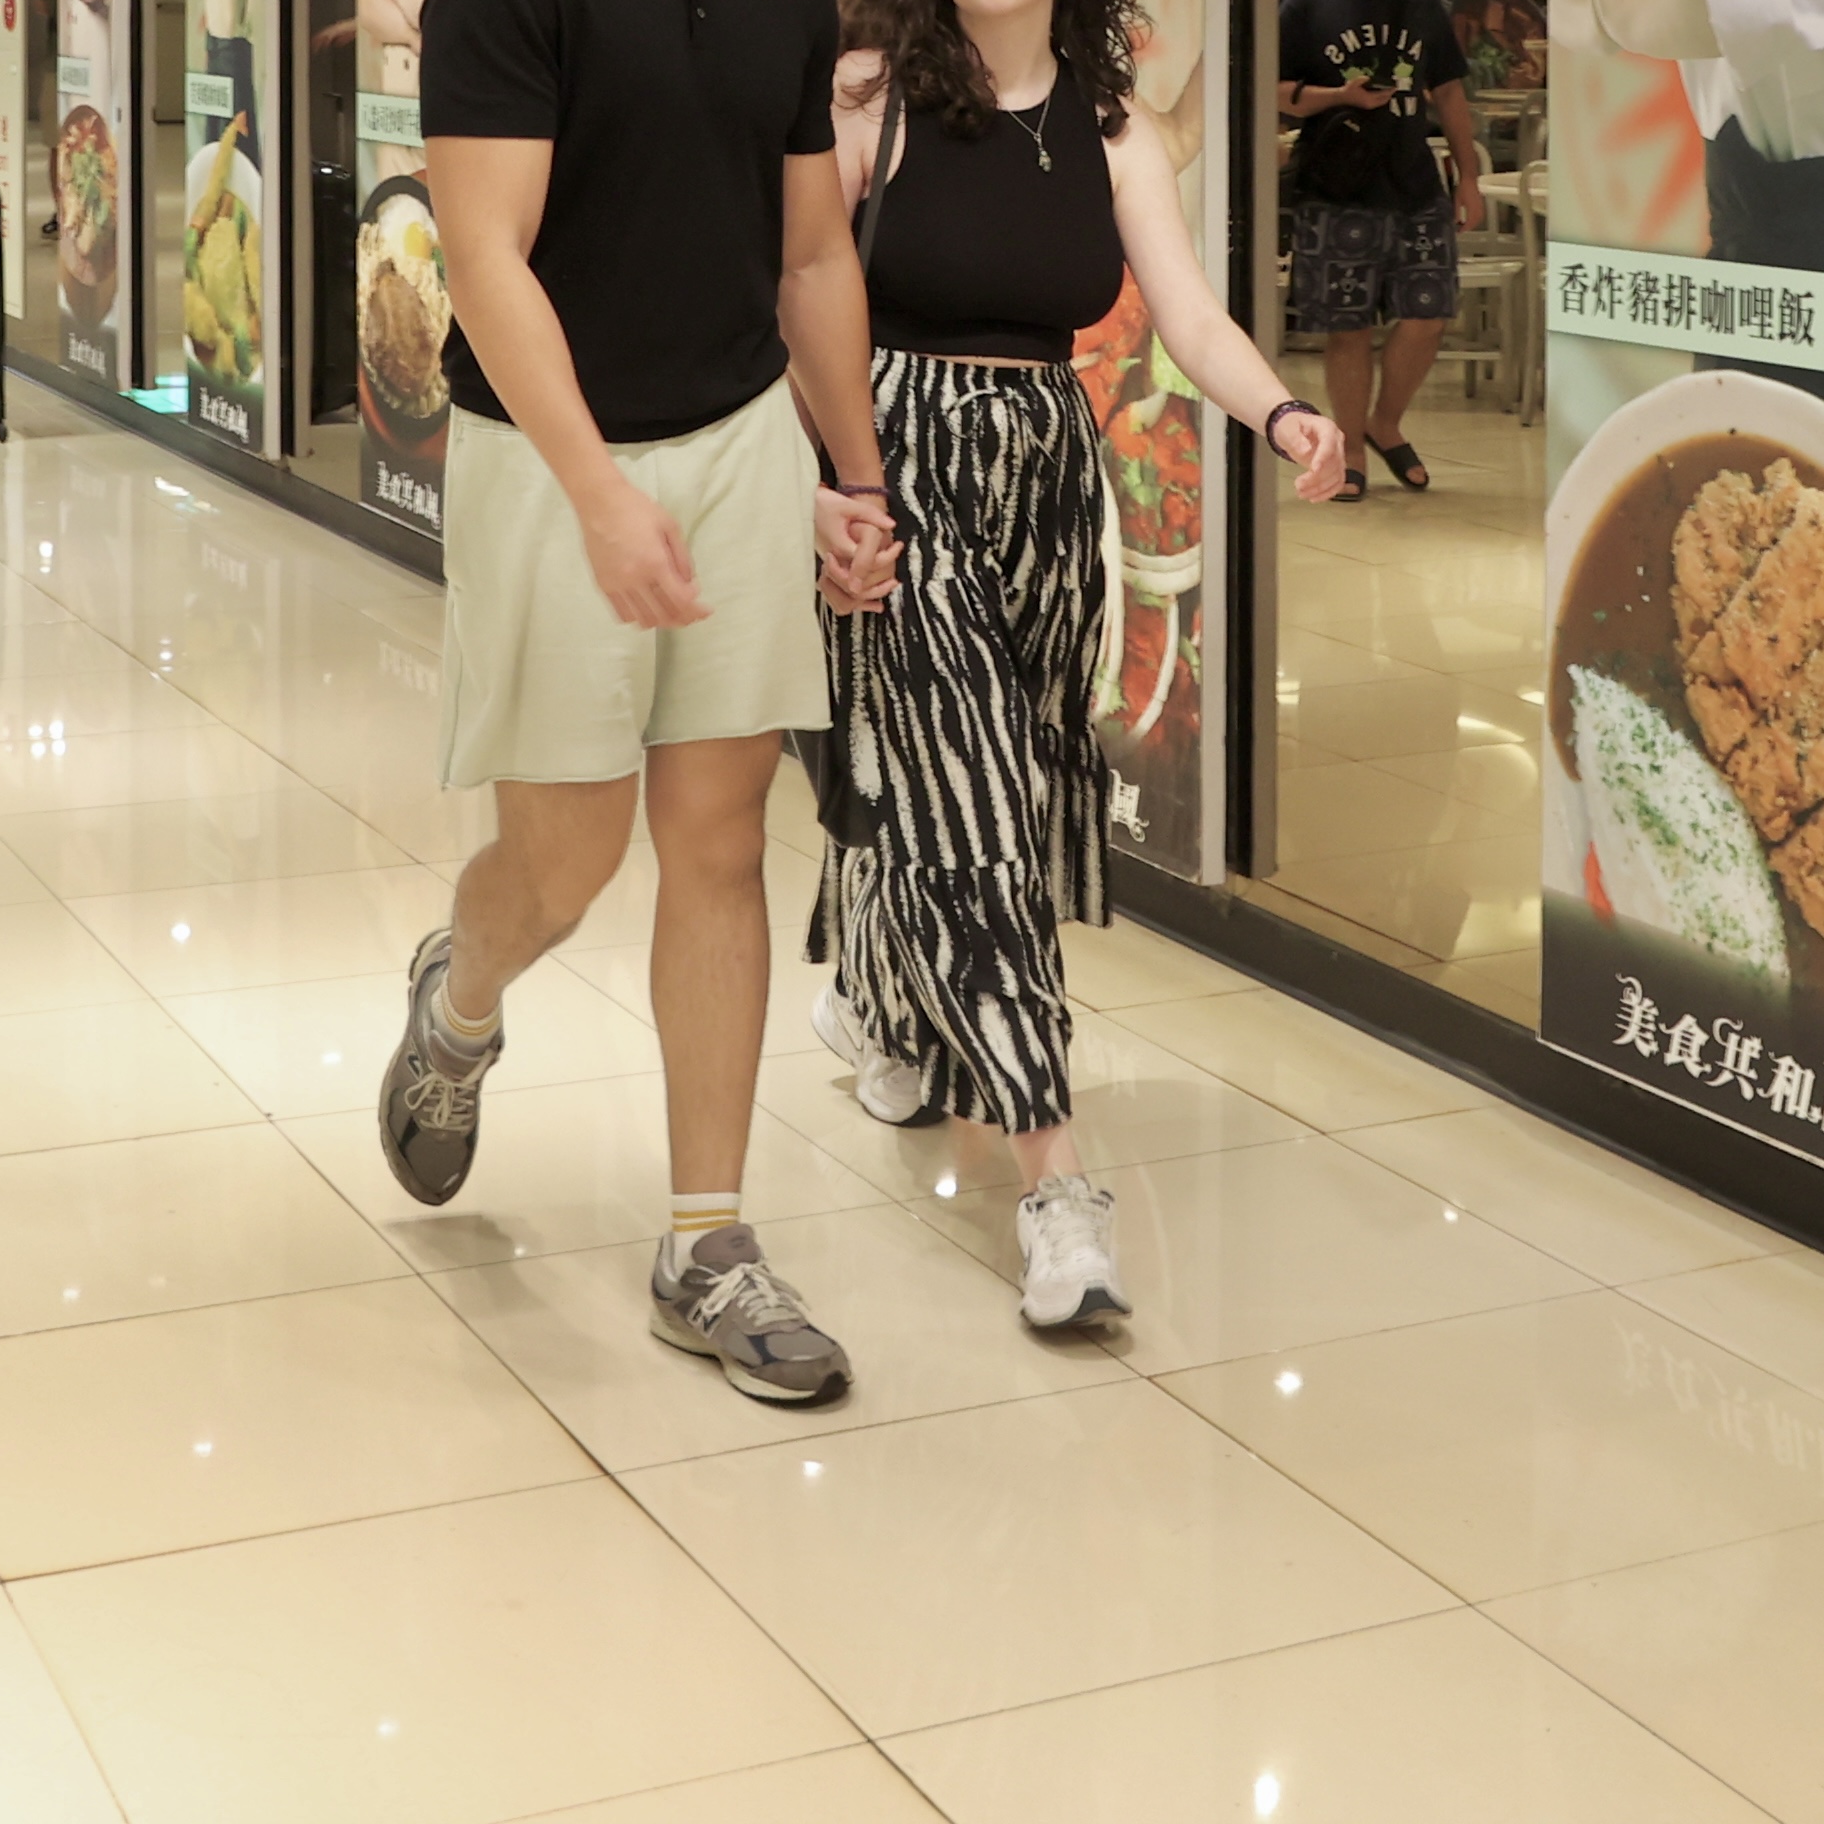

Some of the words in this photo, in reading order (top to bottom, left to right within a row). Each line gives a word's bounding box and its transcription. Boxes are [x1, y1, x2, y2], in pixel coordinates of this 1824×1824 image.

[1558, 261, 1816, 348] 香炸豬排咖哩飯
